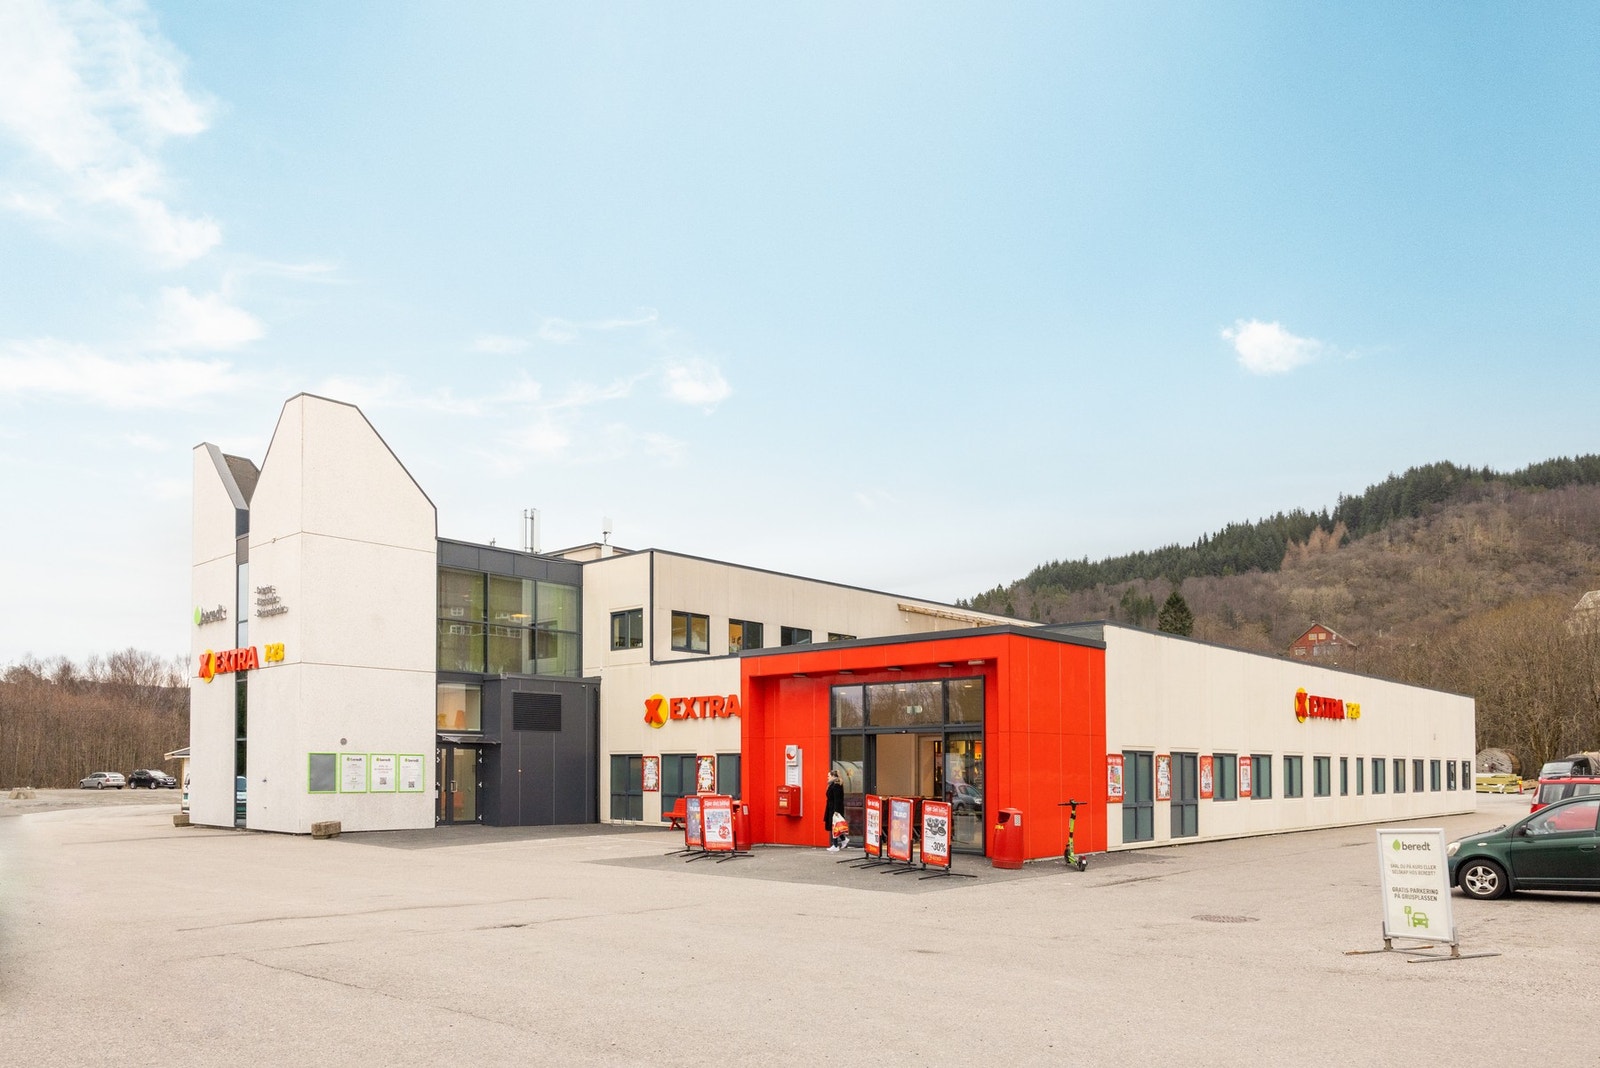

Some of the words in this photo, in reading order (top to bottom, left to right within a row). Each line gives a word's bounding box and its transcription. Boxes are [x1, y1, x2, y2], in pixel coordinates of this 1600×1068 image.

[214, 646, 259, 675] EXTRA
[669, 694, 741, 720] EXTRA
[1309, 695, 1345, 720] EXTRA
[1401, 841, 1431, 851] beredt
[1402, 894, 1438, 902] GRUSPLASSEN
